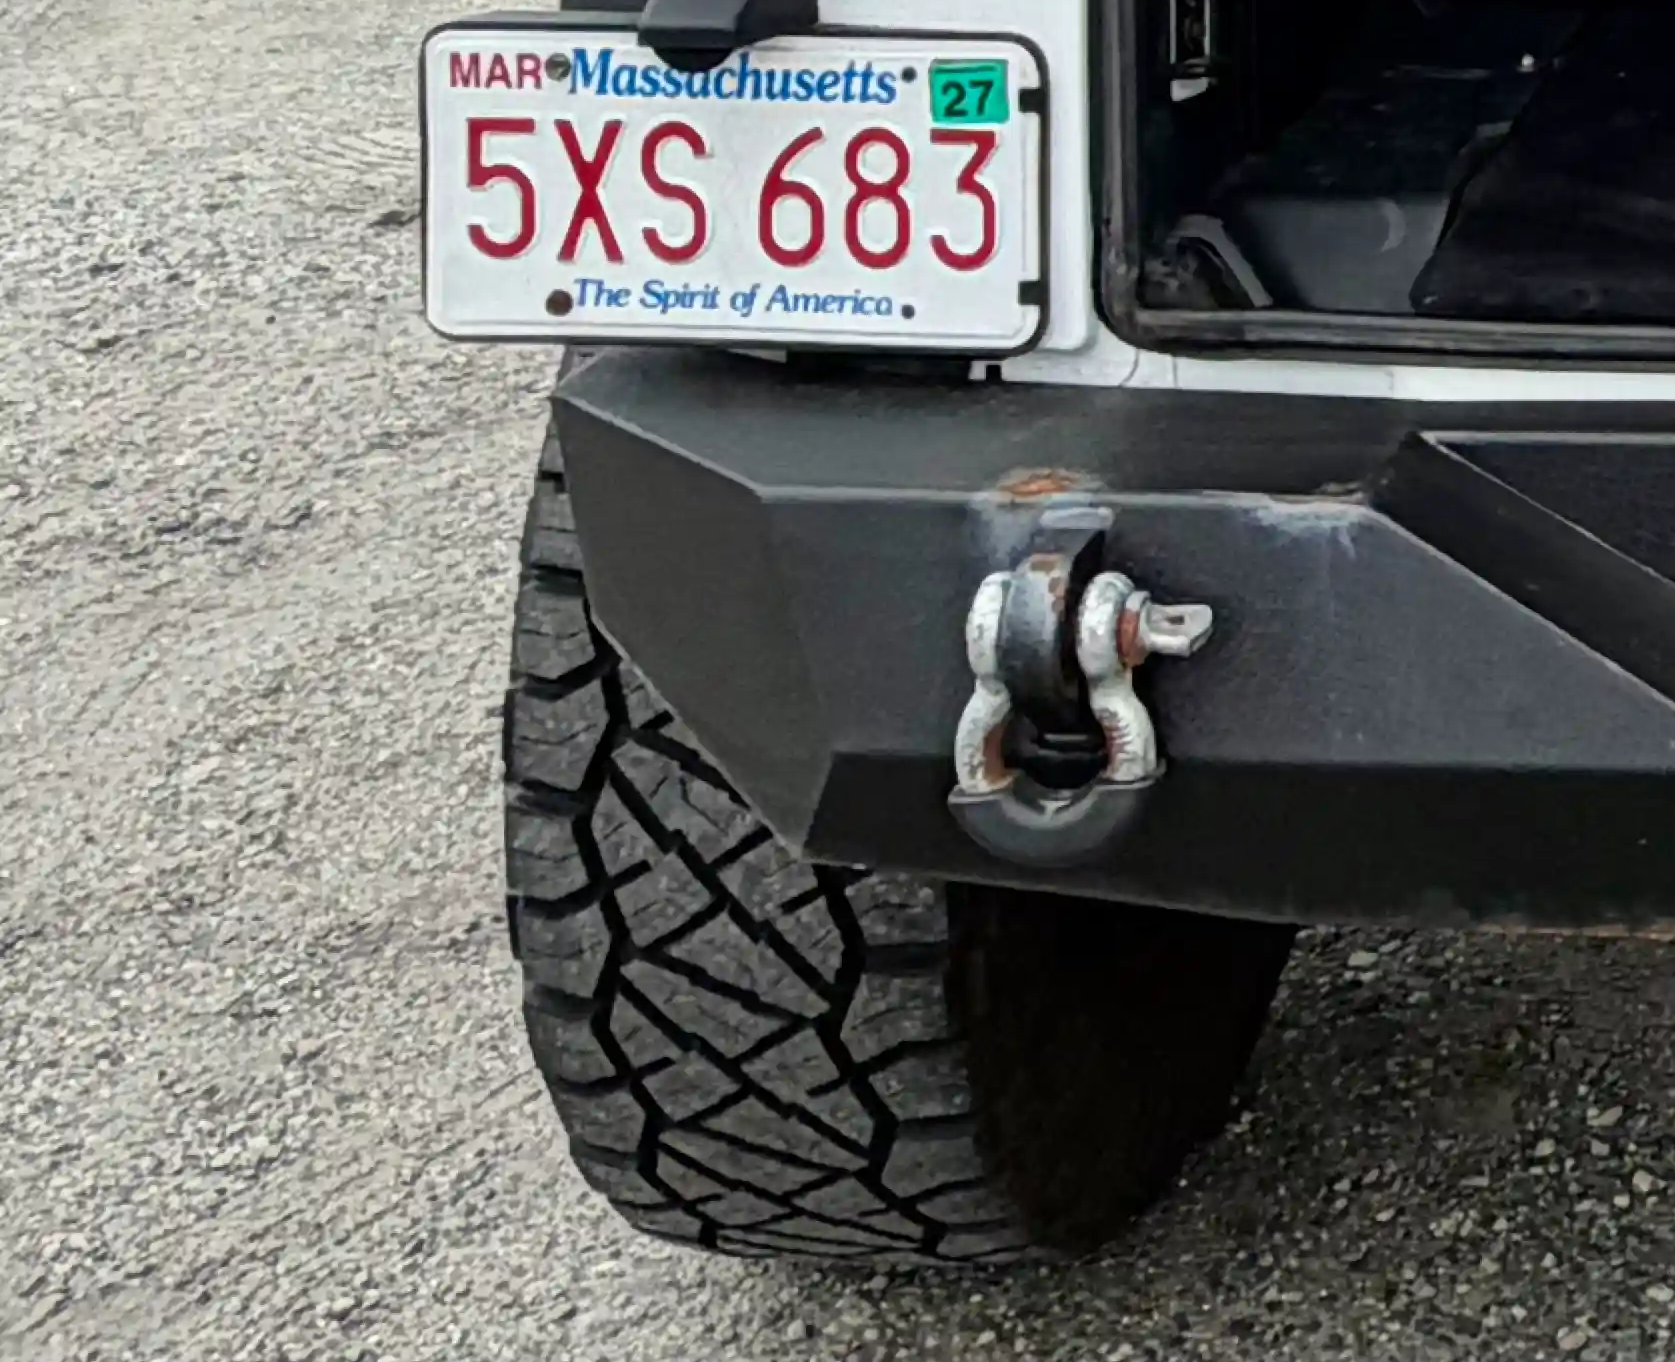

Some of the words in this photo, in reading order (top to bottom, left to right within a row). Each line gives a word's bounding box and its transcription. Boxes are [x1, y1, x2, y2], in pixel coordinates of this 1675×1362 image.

[449, 50, 542, 89] MAR
[568, 47, 897, 104] Massachusetts
[941, 80, 994, 117] 27
[466, 117, 711, 264] 5XS
[758, 126, 998, 271] 683
[574, 277, 632, 308] The
[639, 279, 721, 315] Spirit
[729, 283, 762, 318] of
[765, 283, 894, 316] America
